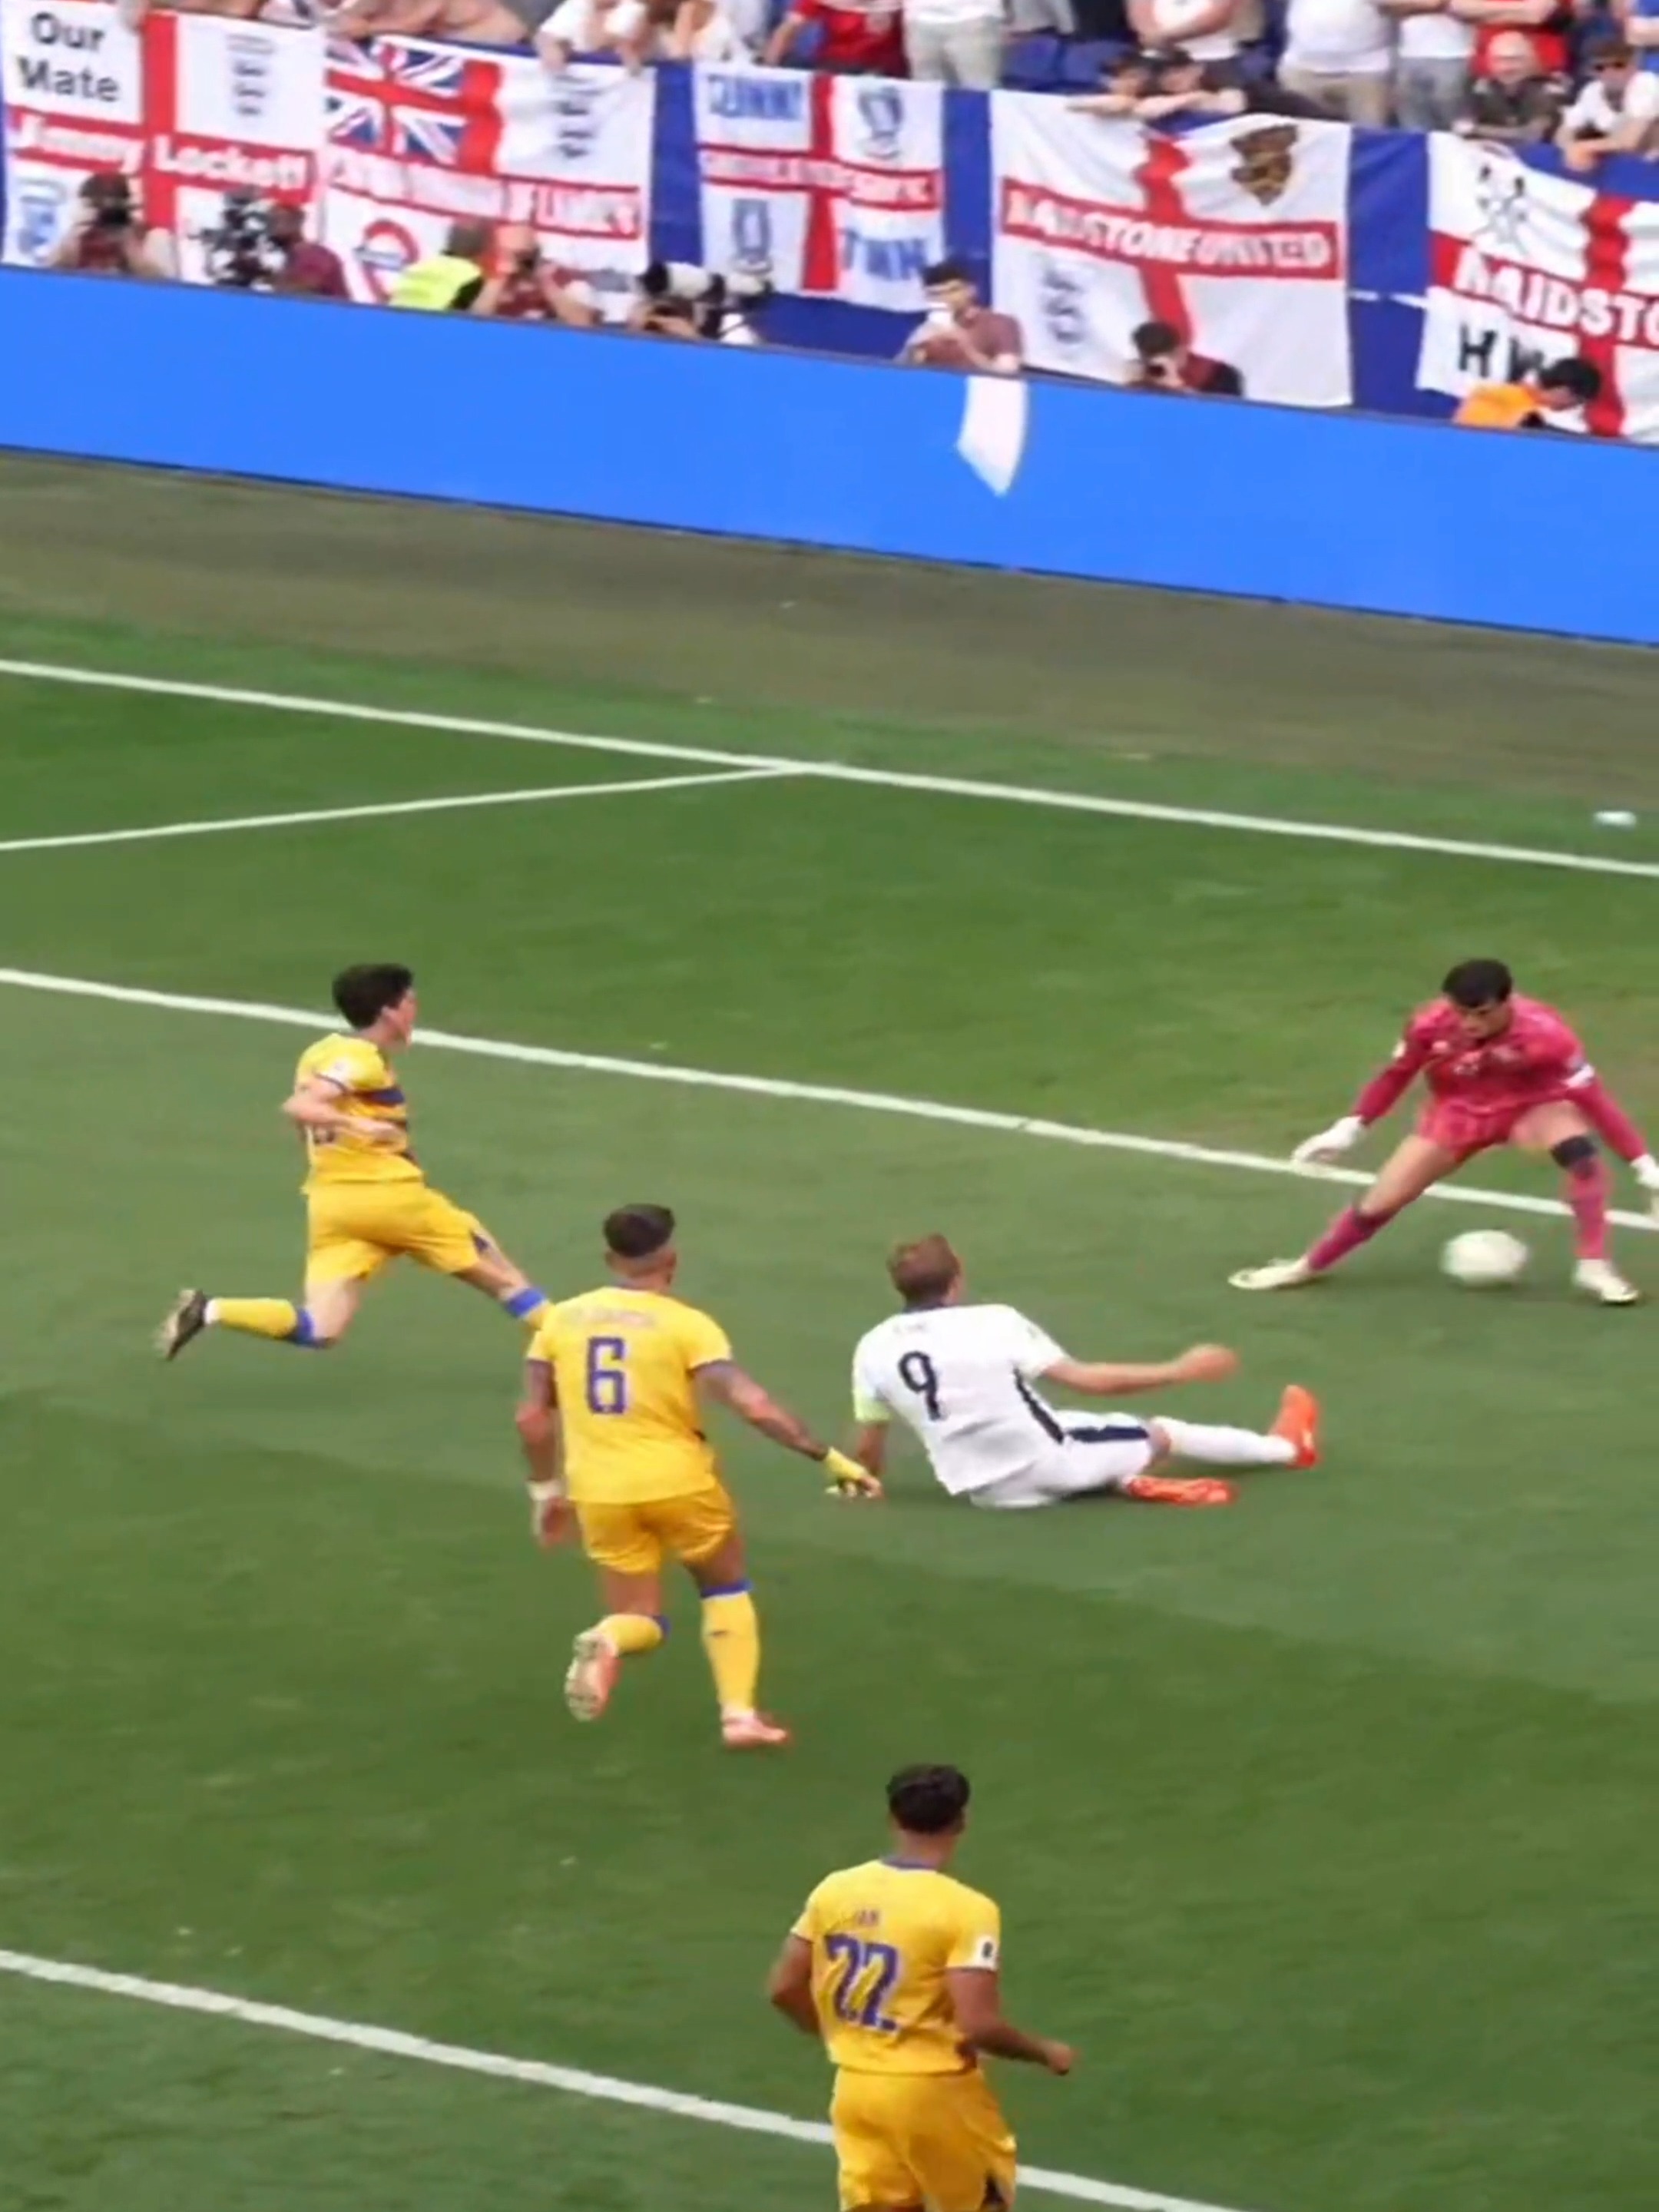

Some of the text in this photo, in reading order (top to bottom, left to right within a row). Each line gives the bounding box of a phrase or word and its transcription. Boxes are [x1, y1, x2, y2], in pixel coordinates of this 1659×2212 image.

[31, 11, 105, 51] Our
[15, 55, 120, 102] Mate
[586, 1335, 625, 1415] 6
[898, 1349, 941, 1421] 9
